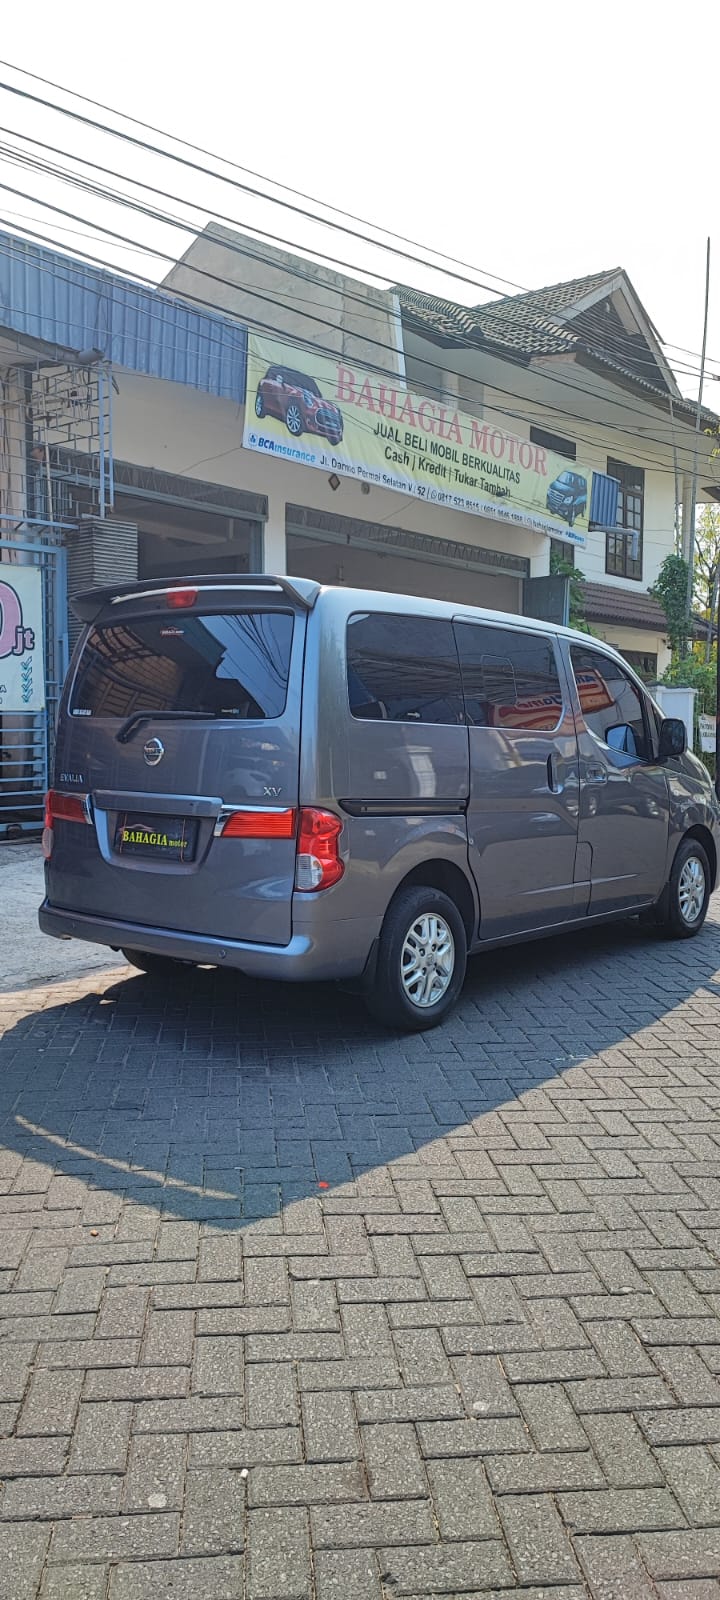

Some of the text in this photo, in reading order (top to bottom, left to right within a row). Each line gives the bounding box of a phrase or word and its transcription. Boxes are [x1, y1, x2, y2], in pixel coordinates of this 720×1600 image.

[335, 363, 547, 476] BAHAGIA MOTOR
[374, 422, 520, 484] JUAL BELI MOBIL BERKUALITAS
[385, 446, 409, 466] Cash
[418, 456, 446, 478] Kredit
[454, 468, 478, 487] Tukar
[263, 786, 282, 797] XV
[122, 830, 188, 848] BAHAGIA motor
